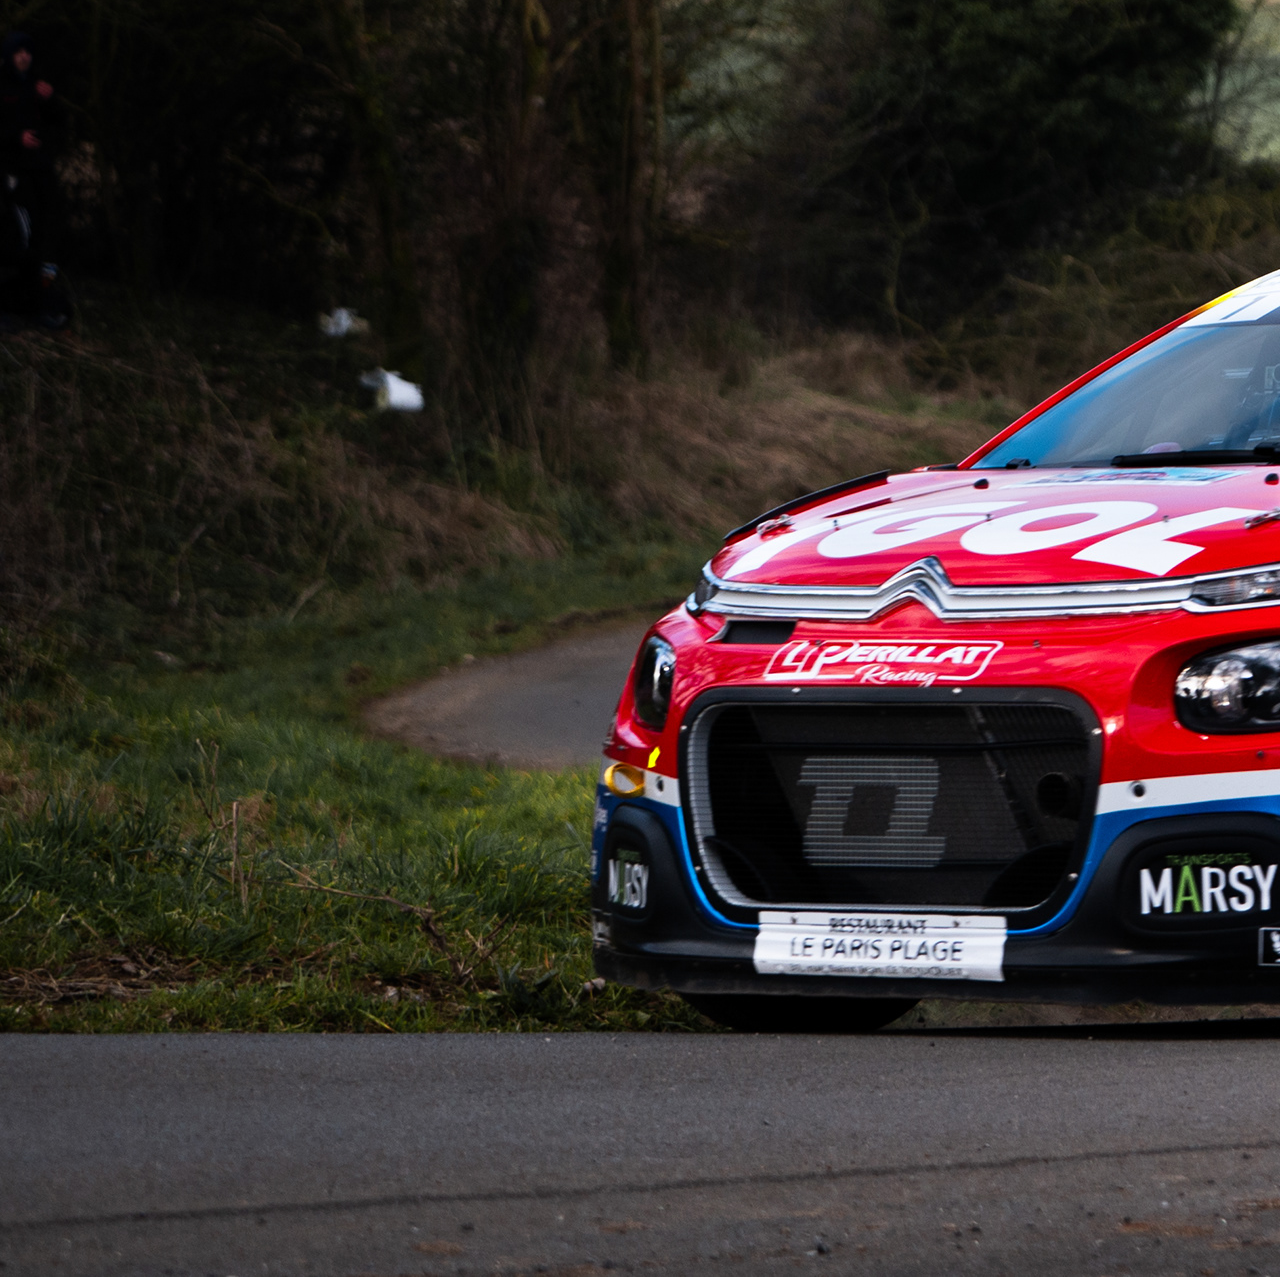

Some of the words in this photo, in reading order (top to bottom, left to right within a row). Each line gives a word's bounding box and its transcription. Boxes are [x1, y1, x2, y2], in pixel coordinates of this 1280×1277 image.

[722, 500, 1268, 577] IGOL
[854, 663, 938, 687] Racing
[1139, 863, 1279, 915] MARSY
[828, 917, 928, 934] RESTAURANT
[790, 936, 816, 957] LE
[821, 938, 883, 959] PARIS
[889, 939, 966, 962] PLAGE
